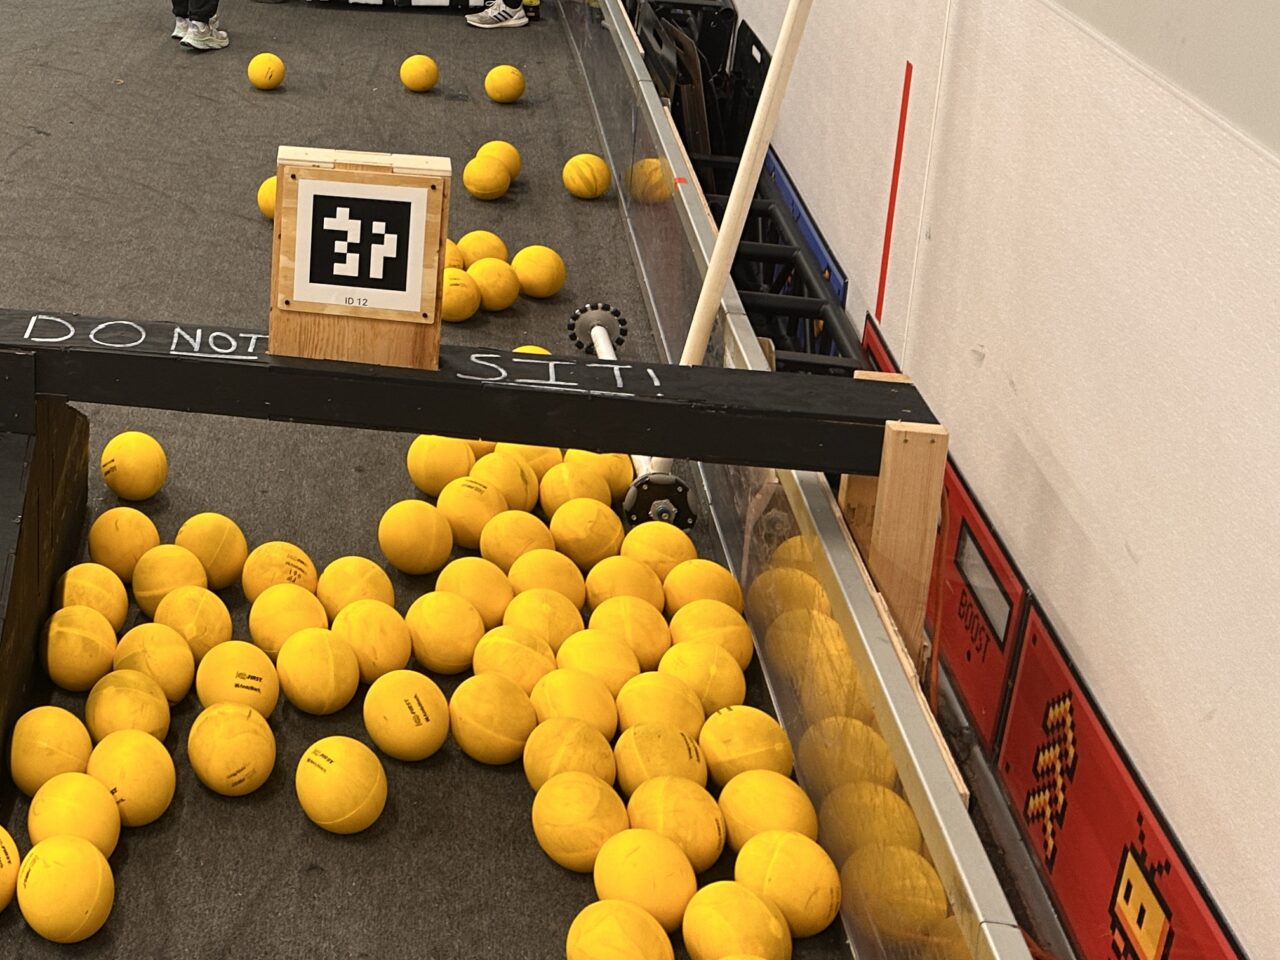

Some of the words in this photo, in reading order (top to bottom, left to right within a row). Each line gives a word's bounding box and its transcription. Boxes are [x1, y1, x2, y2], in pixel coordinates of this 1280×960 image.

[344, 297, 355, 305] ID
[357, 298, 369, 307] 12
[24, 314, 146, 348] DO
[170, 326, 270, 354] NOT
[958, 587, 992, 664] BOOST
